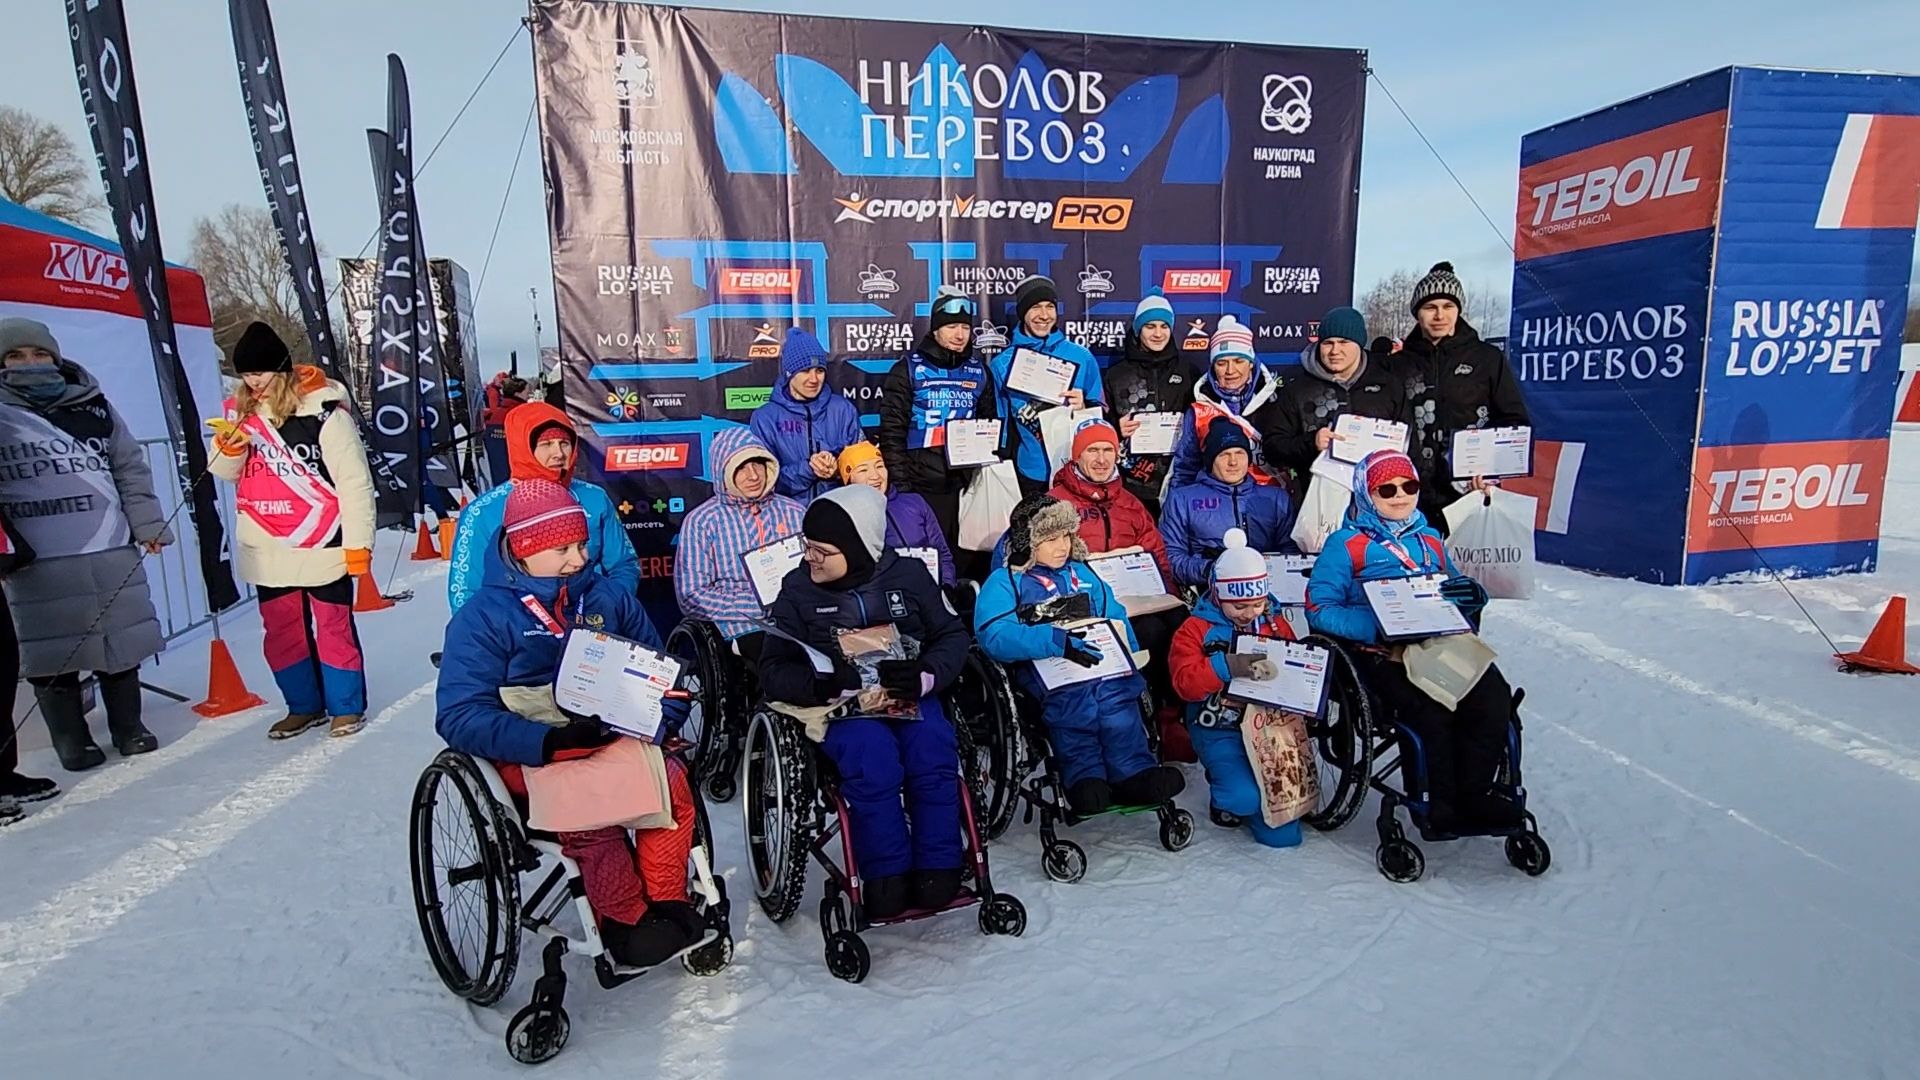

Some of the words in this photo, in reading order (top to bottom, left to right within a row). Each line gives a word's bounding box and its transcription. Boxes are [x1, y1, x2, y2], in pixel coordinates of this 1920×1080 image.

[859, 59, 1106, 115] НИКОЛОВ
[590, 129, 683, 147] МОСКОВСКАЯ
[861, 115, 1106, 164] ПЕРЕВОЗ
[605, 148, 671, 165] ОБЛАСТЬ
[1253, 147, 1316, 165] НАУКОГРАД
[1266, 164, 1302, 180] ДУБНА
[1532, 145, 1700, 226] TEBOIL
[1058, 203, 1125, 225] PRO
[1531, 220, 1577, 238] МОТОРНЫЕ
[1577, 213, 1611, 230] МАСЛА
[597, 265, 673, 281] RUSSIA
[728, 271, 793, 288] TEBOIL
[954, 267, 1026, 281] НИКОЛОВ
[1170, 273, 1223, 288] TEBOIL
[1264, 267, 1321, 281] RUSSIA
[599, 281, 674, 296] LOPPET
[955, 281, 1018, 296] ПЕРЕВО
[1264, 281, 1321, 294] LOPPET
[1522, 304, 1687, 346] НИКОЛОВ
[1732, 300, 1883, 339] RUSSIA
[846, 323, 913, 338] RUSSIA
[1065, 321, 1126, 335] RUSSIA
[1259, 325, 1303, 338] MOAX
[597, 332, 657, 347] MOAX
[846, 338, 914, 352] LOPPET
[1183, 340, 1208, 348] PRO
[751, 346, 778, 356] PRO
[1726, 339, 1882, 377] LOPPET
[1520, 344, 1685, 381] ПЕРЕВОЗ
[731, 393, 771, 403] POWE
[843, 387, 884, 399] MOA
[927, 391, 974, 400] НИКОЛОВ
[653, 398, 682, 407] ДУБНА
[927, 400, 974, 408] ПЕРЕВОЗ
[247, 444, 322, 460] КОЛОВ
[615, 447, 679, 464] TEBOIL
[244, 461, 320, 478] ЕРЕВОЗ
[1707, 463, 1869, 515] TEBOIL
[5, 494, 94, 519] КОМИТЕТ
[1707, 515, 1759, 528] МОТОРНЫЕ
[1760, 513, 1794, 524] МАСЛА
